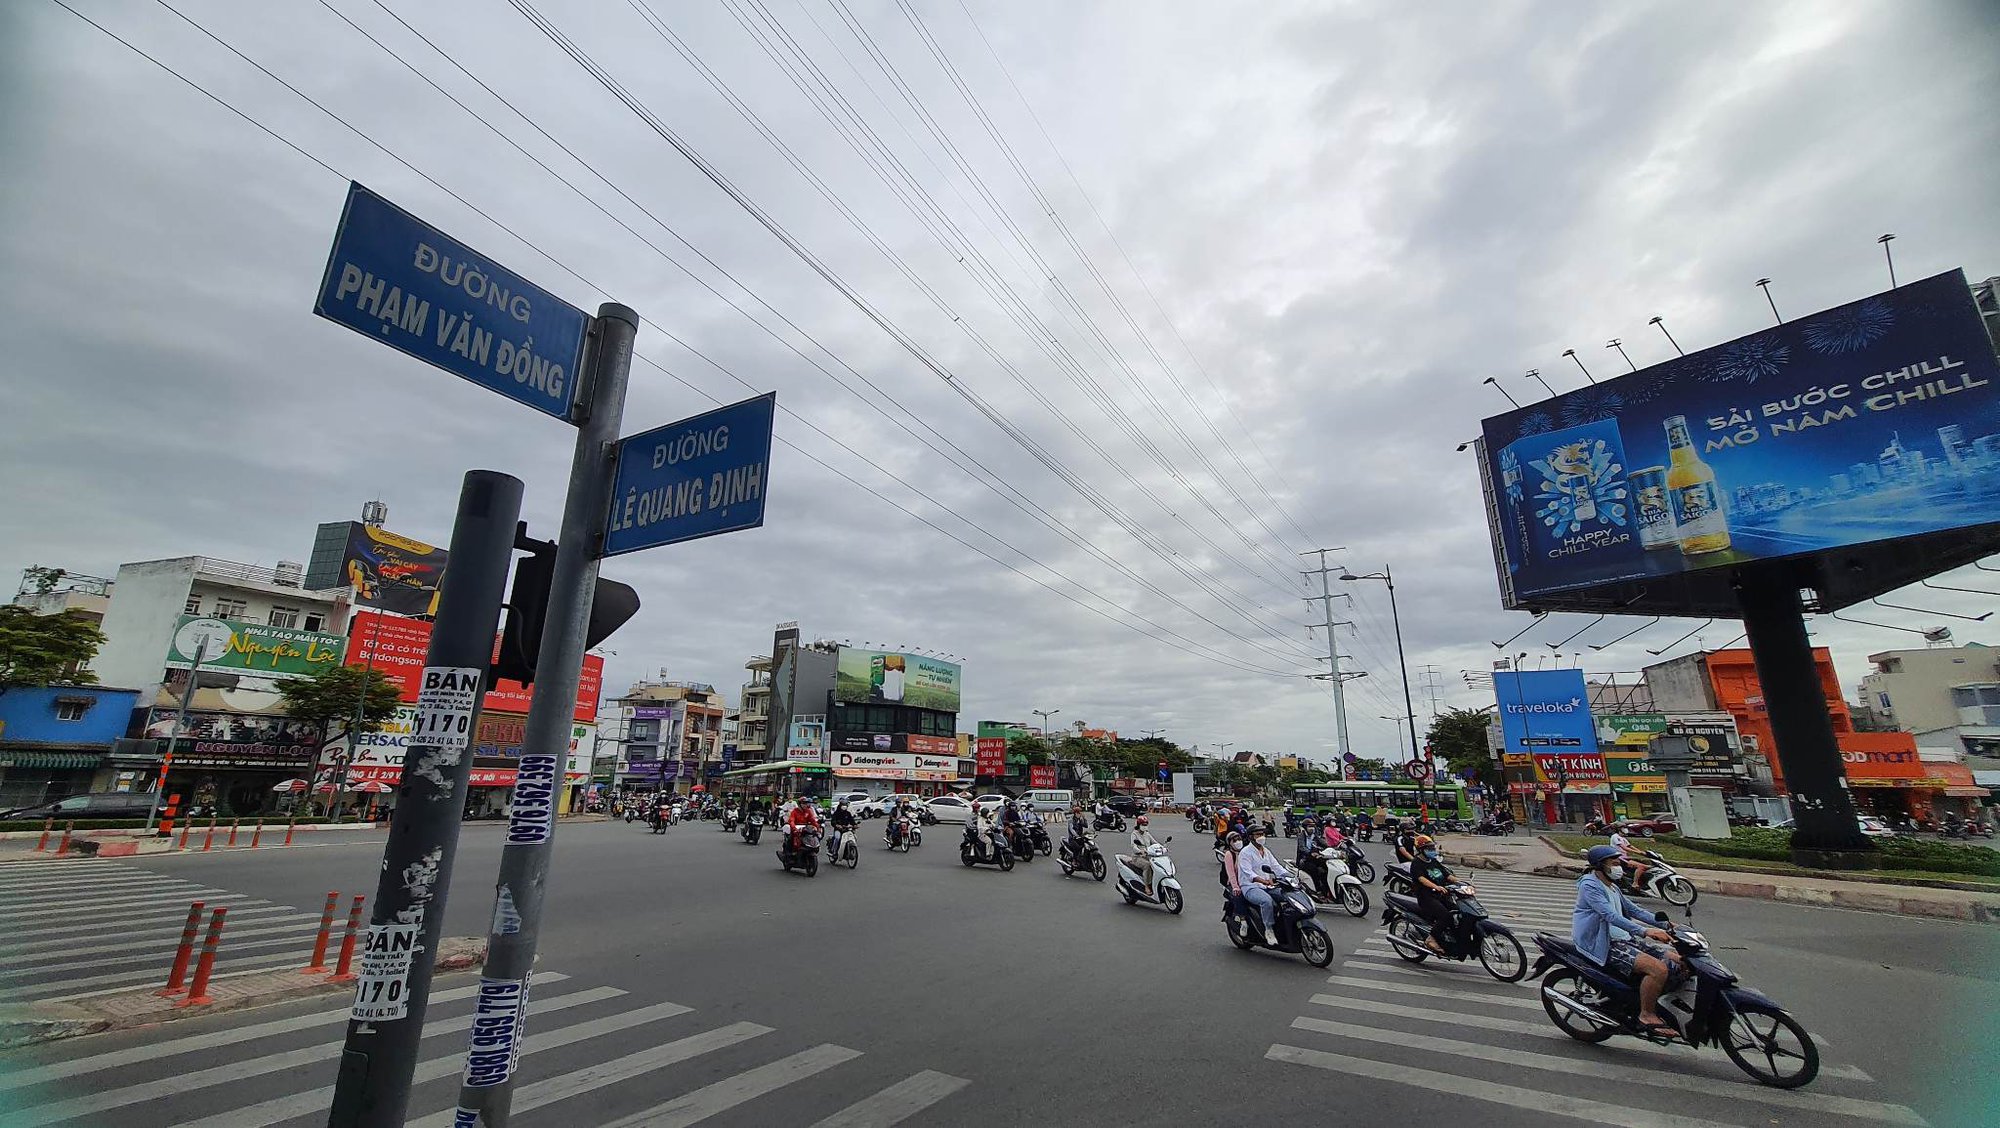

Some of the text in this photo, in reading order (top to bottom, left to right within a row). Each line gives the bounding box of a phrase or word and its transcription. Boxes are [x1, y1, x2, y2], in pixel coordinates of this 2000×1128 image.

[413, 242, 532, 324] ĐƯỜNG
[335, 261, 565, 399] PHẠM VĂN ĐỒNG
[1706, 355, 1965, 431] SẢI BƯỚC CHILL
[1704, 426, 1760, 454] MỞ
[1863, 373, 1989, 411] CHILL
[652, 425, 729, 469] ĐƯỜNG
[611, 462, 762, 532] LÊ QUANG ĐỊNH
[1638, 511, 1669, 524] SAIGO
[1548, 533, 1630, 558] CHILL YEAR
[1563, 528, 1613, 547] HAPPY
[244, 627, 268, 637] NHÀ
[305, 642, 337, 663] Lộc
[397, 644, 410, 653] có
[425, 669, 478, 692] BÁN
[1506, 702, 1574, 713] traveloka
[356, 734, 408, 747] ERSAC
[1571, 755, 1602, 770] KÍNH
[508, 756, 556, 842] 0976.562.599
[365, 926, 414, 952] BÁN
[360, 979, 402, 1003] 170
[466, 984, 520, 1086] 0981.959.779
